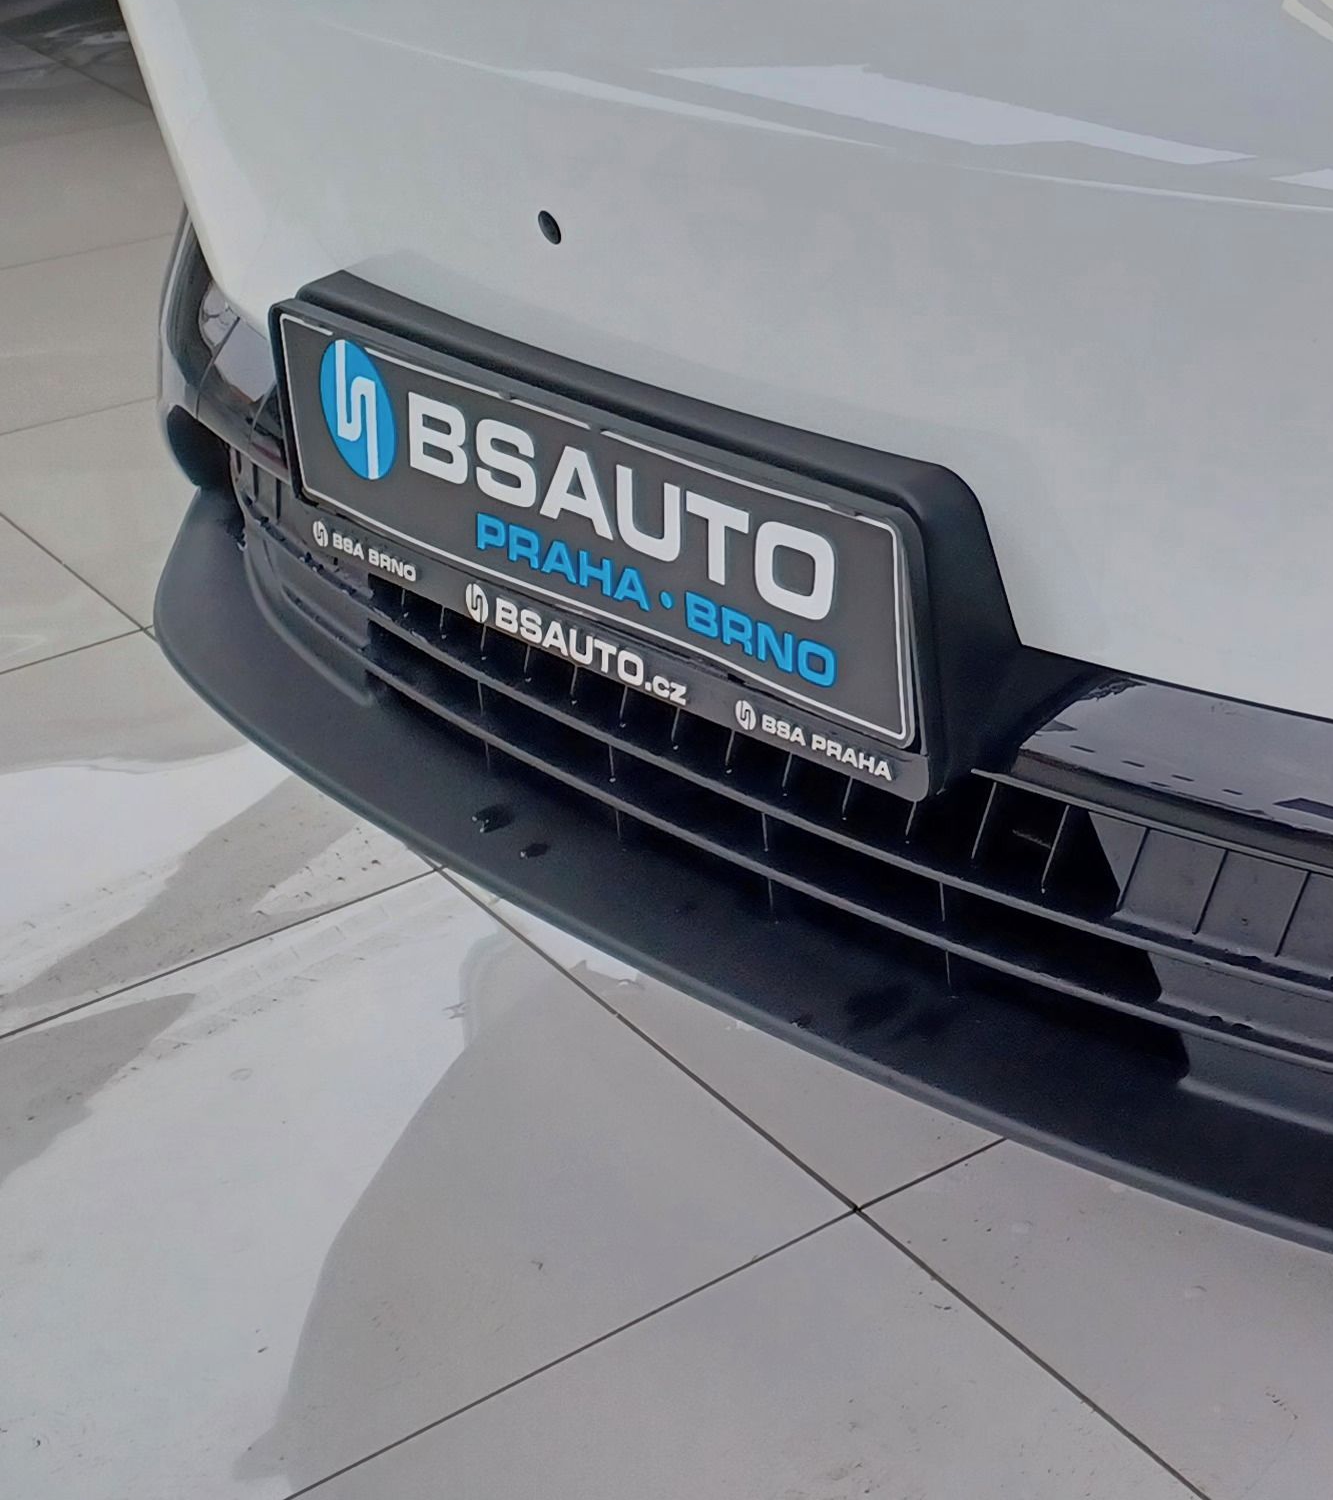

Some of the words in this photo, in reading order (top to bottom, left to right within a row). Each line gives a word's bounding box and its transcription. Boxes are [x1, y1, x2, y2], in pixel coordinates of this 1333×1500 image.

[332, 532, 365, 561] BSA
[368, 548, 417, 582] BRNO
[408, 391, 837, 621] BSAUTO
[476, 512, 651, 611] PRAHA
[684, 590, 837, 688] BRNO
[495, 598, 688, 705] BSAUTO.cz
[761, 714, 806, 747] BSA
[811, 733, 892, 781] PRAHA
